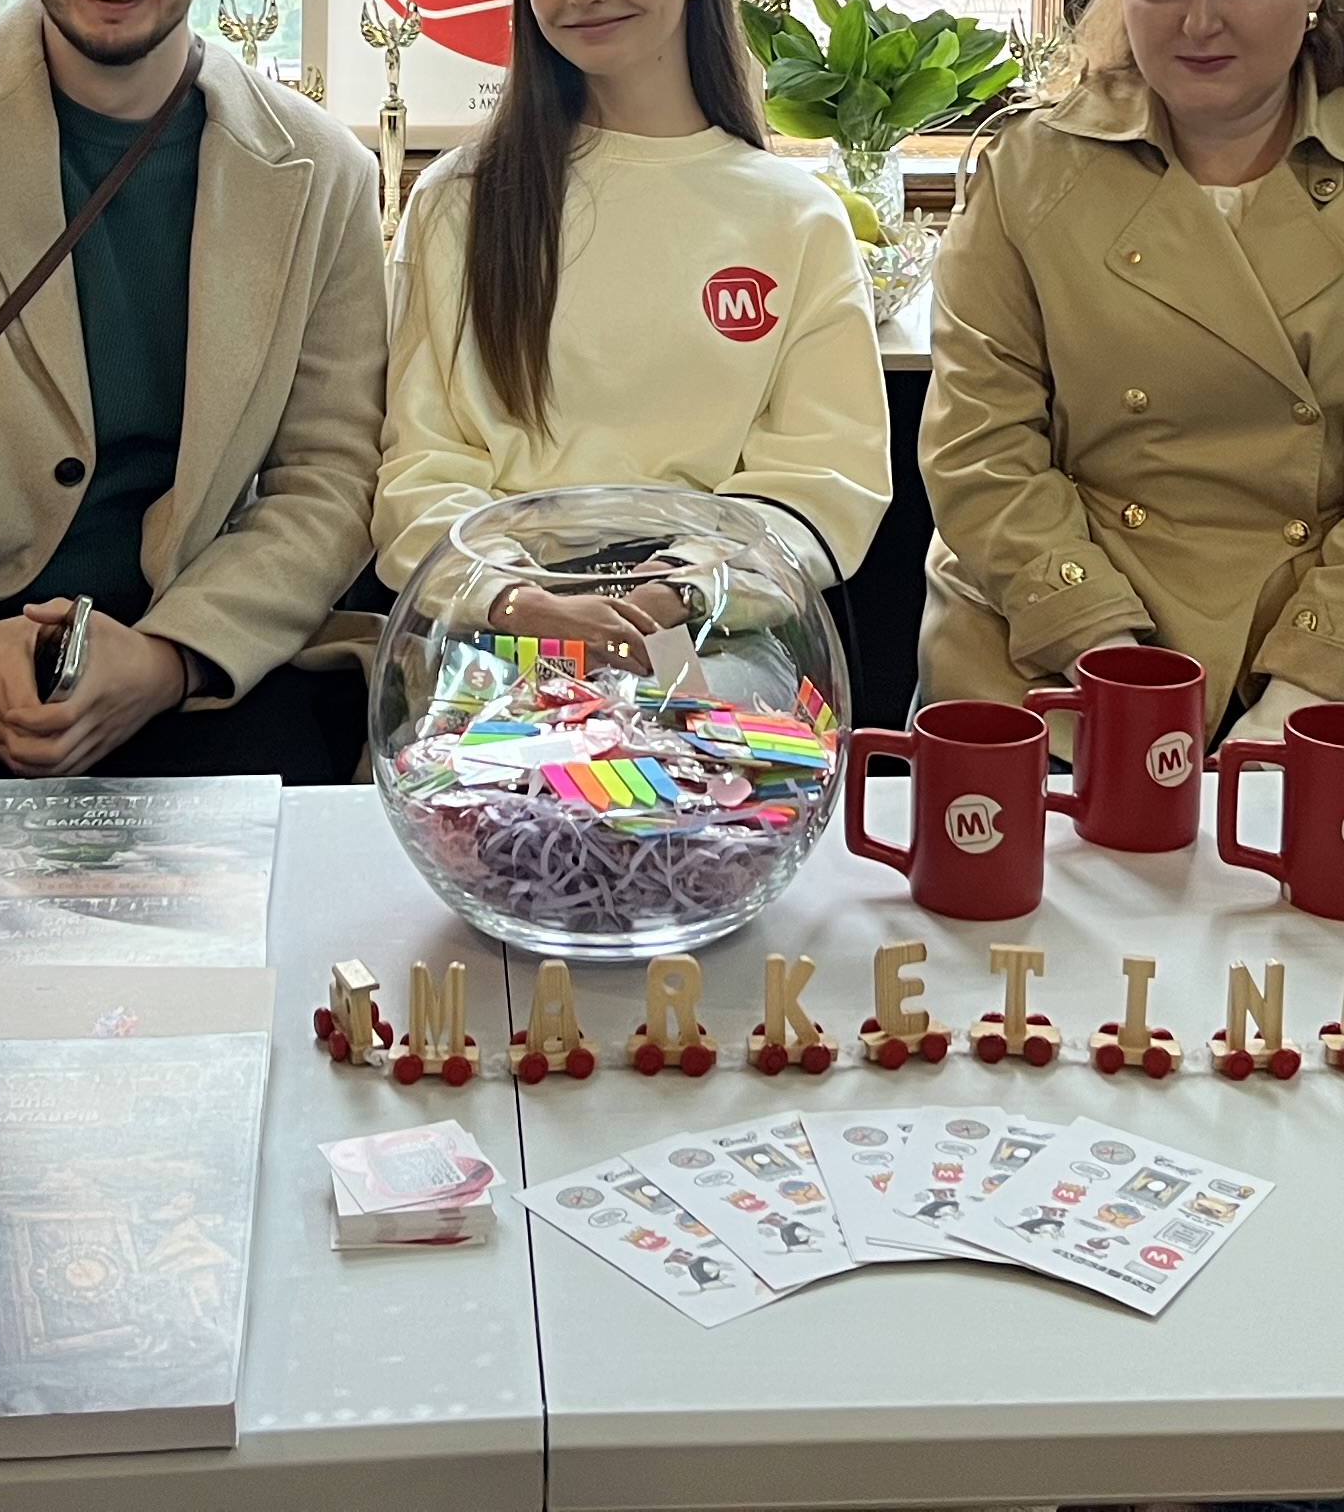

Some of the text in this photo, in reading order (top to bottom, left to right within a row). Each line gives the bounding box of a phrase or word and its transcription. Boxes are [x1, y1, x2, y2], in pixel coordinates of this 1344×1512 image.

[718, 289, 757, 320] M
[1158, 747, 1182, 775] M
[958, 813, 985, 837] M
